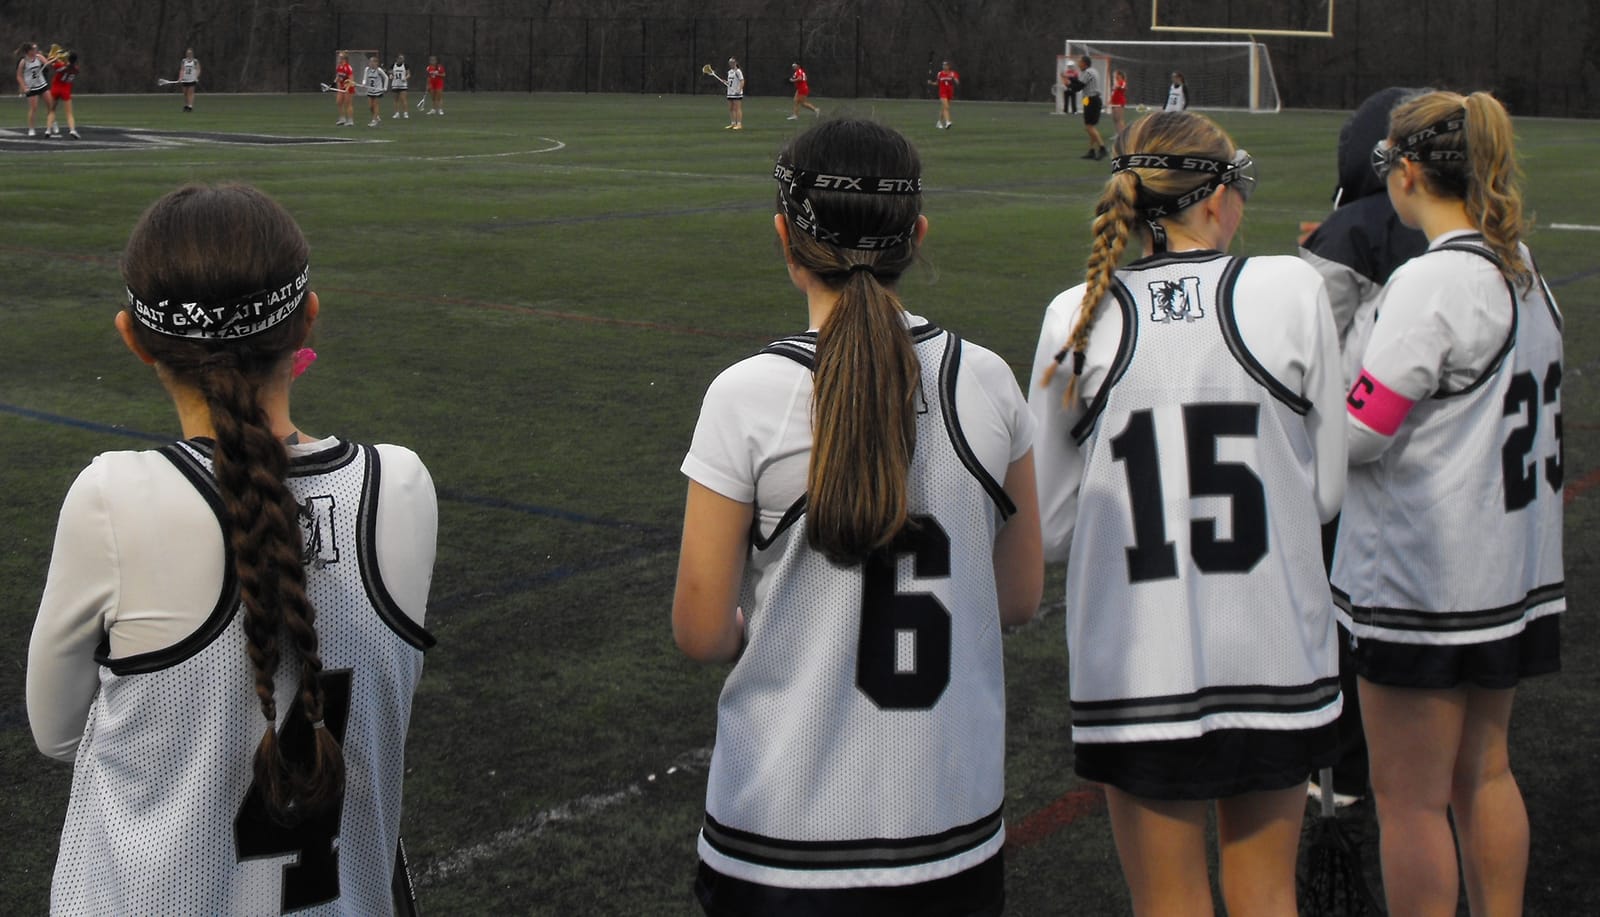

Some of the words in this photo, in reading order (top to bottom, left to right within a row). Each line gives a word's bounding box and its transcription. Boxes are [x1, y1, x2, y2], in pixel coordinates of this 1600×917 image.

[1128, 155, 1169, 168] STX
[1183, 158, 1220, 172] STX
[814, 174, 862, 191] STX
[877, 178, 915, 192] STX
[1177, 183, 1213, 209] STX
[857, 232, 905, 248] STX
[267, 283, 293, 306] AIT
[136, 299, 165, 324] GAIT
[1346, 375, 1374, 410] C
[1501, 362, 1564, 514] 23
[1109, 401, 1269, 584] 15
[855, 513, 952, 712] 6
[234, 667, 353, 915] 4
